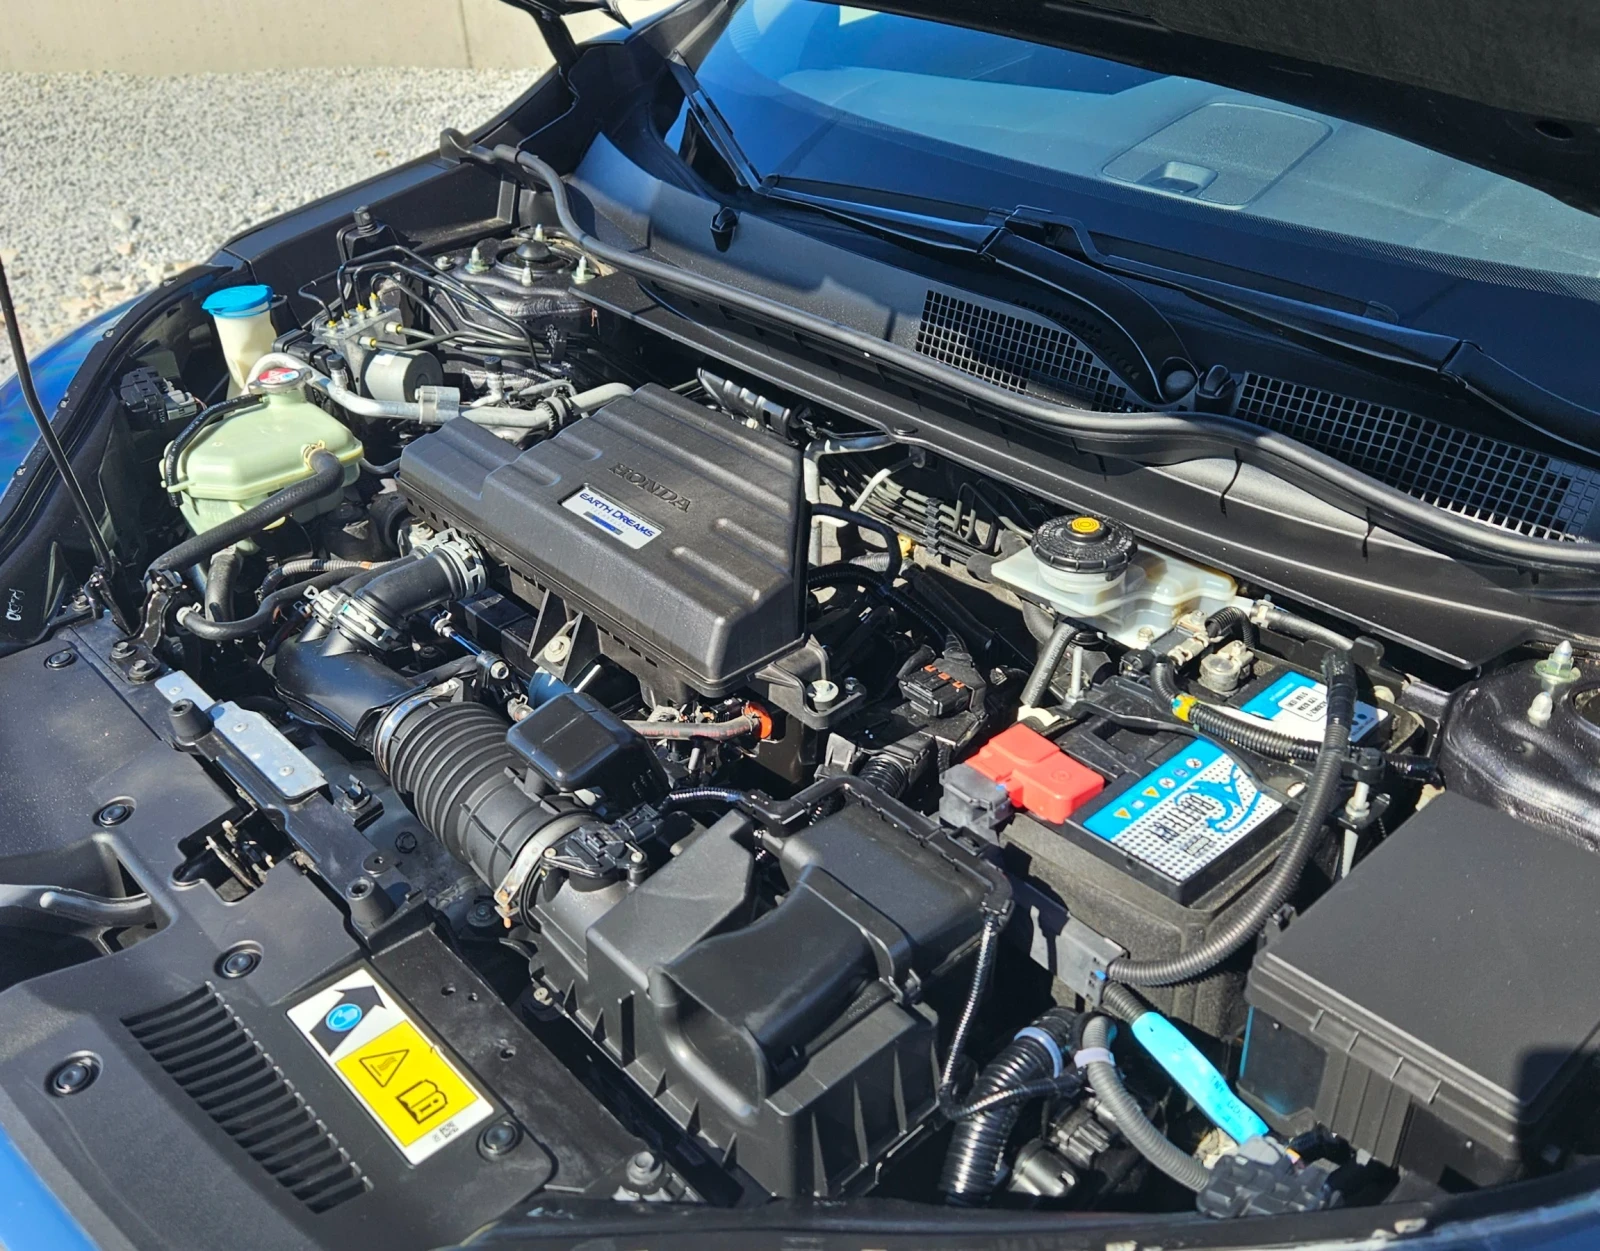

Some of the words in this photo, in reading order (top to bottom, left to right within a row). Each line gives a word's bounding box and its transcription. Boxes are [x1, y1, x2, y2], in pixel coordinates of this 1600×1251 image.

[579, 492, 615, 515] EARTH
[608, 462, 691, 513] HONDA
[1146, 793, 1216, 844] BATTERY
